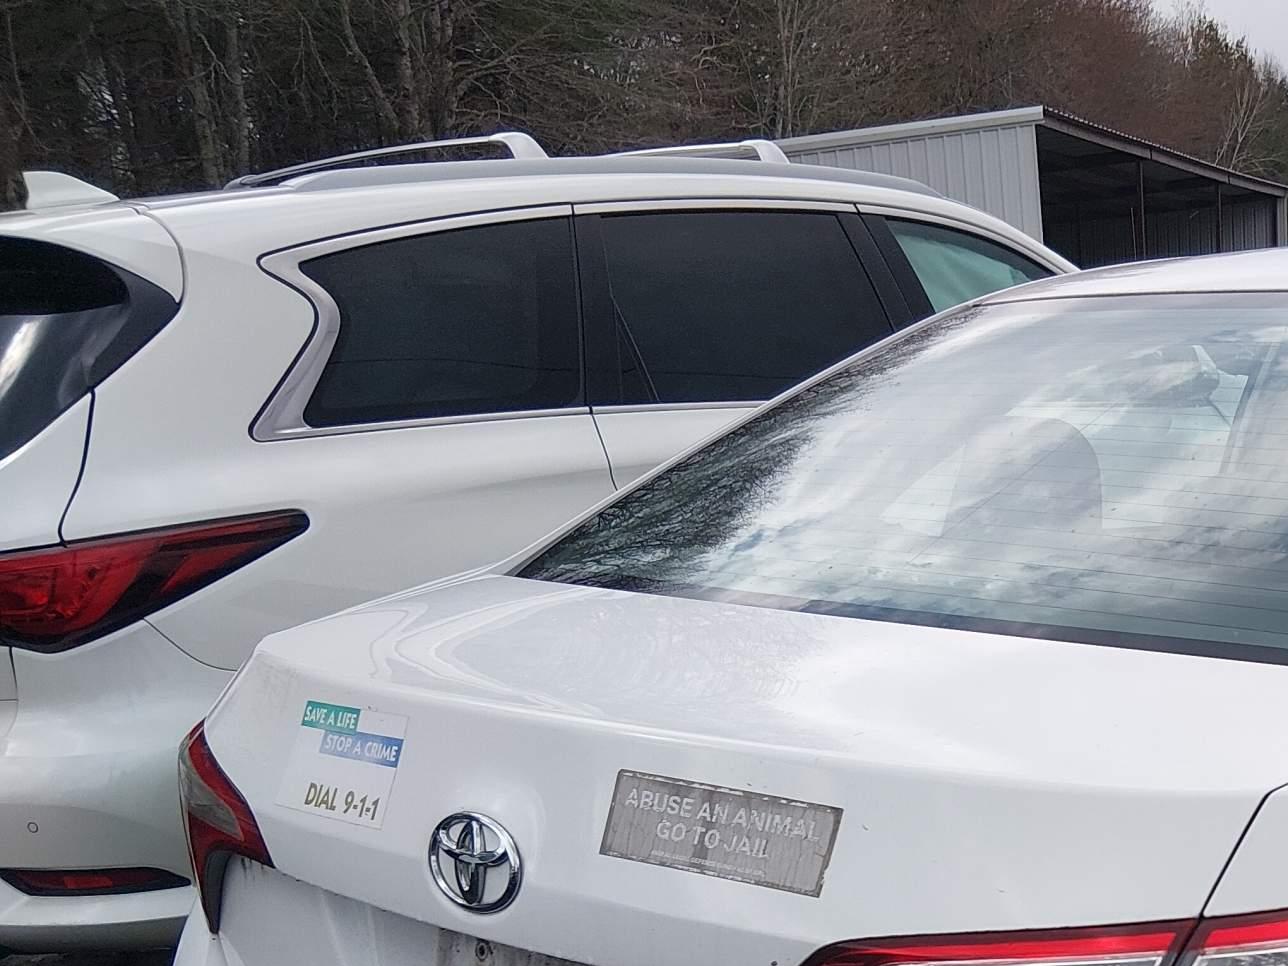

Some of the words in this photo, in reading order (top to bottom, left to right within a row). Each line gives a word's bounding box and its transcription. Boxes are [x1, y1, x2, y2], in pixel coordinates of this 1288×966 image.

[304, 706, 327, 724] SAVE
[326, 712, 335, 726] A
[336, 711, 357, 729] LIFE
[325, 735, 353, 753] STOP
[352, 742, 361, 754] A
[364, 741, 398, 761] CRIME
[304, 782, 338, 811] DIAL
[343, 790, 380, 821] 9-1-1
[625, 788, 695, 818] ABUSE
[696, 801, 728, 824] AN
[731, 807, 820, 842] ANIMAL
[656, 819, 686, 842] GO
[692, 825, 720, 849] TO
[723, 834, 769, 859] JAIL
